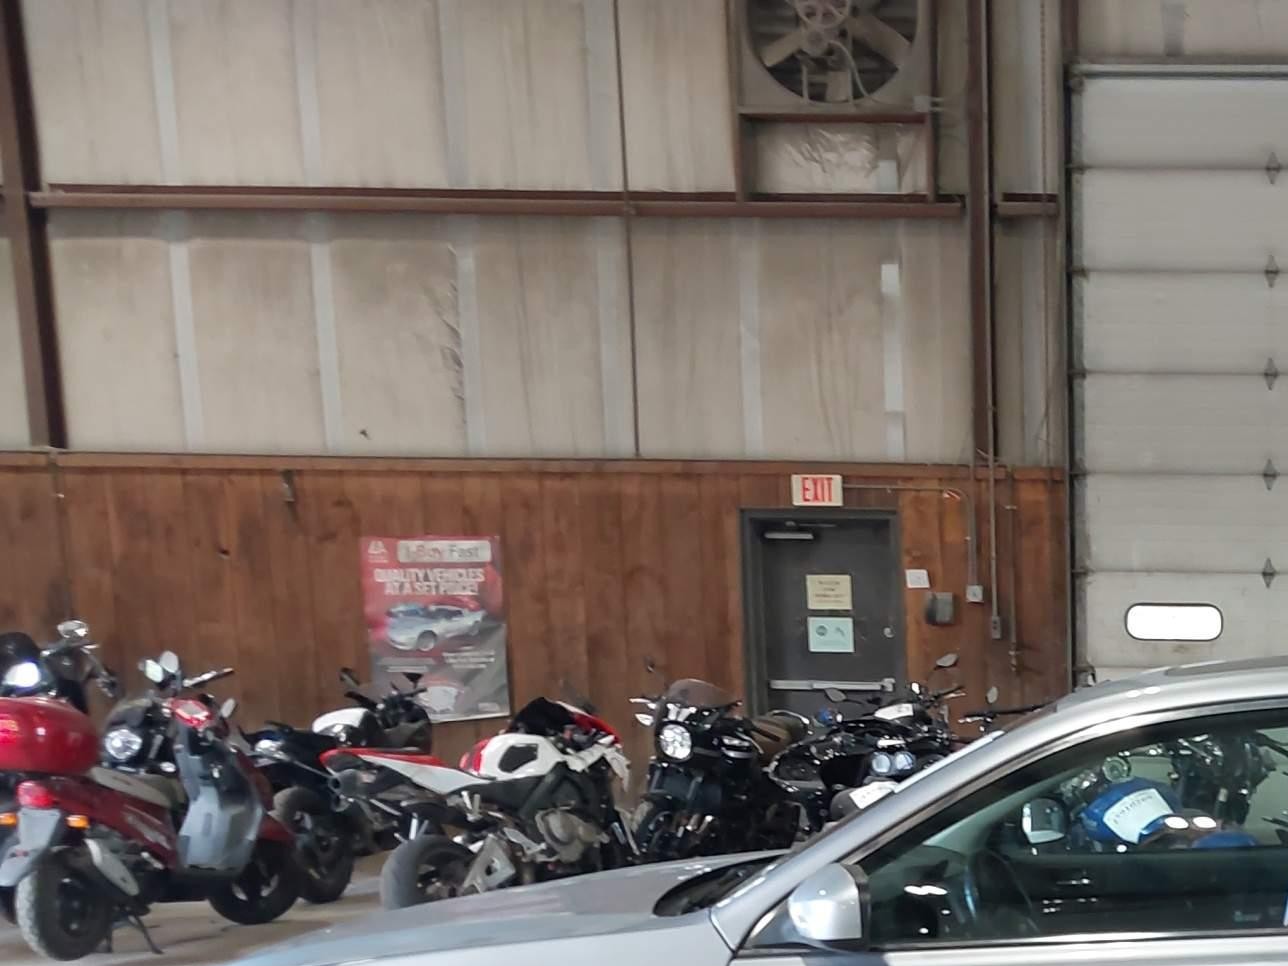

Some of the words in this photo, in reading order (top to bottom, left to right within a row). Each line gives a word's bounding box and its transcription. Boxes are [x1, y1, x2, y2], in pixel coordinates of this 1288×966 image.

[801, 476, 833, 502] EXIT
[447, 544, 480, 558] Fast
[374, 568, 425, 582] QUALITY
[427, 568, 485, 582] VEHICLES
[384, 582, 400, 595] AT
[400, 582, 412, 595] A
[415, 582, 437, 595] SET
